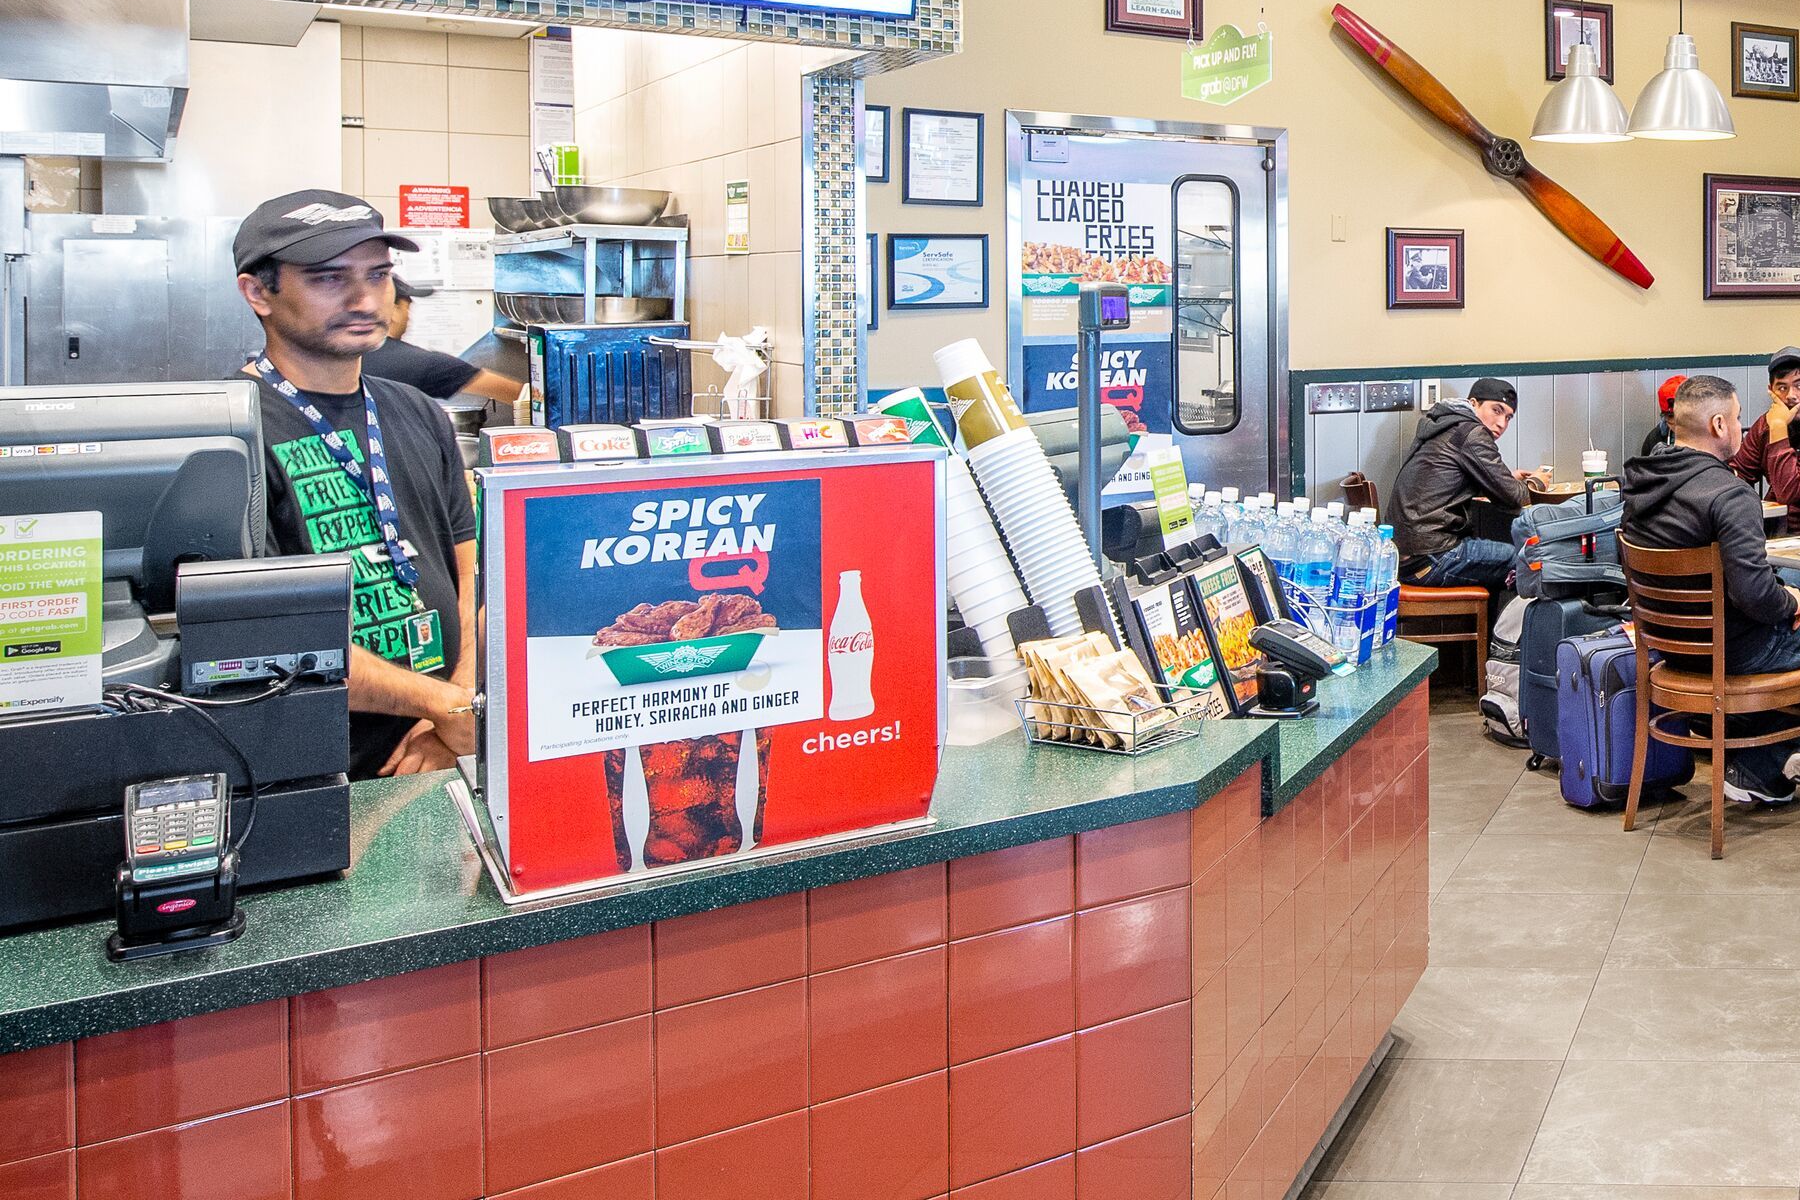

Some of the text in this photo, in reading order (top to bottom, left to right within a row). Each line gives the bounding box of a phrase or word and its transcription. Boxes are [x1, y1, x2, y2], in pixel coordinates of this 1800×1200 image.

[1192, 42, 1257, 70] PICK UP AND FLY!
[1036, 197, 1124, 223] LOADED
[1085, 224, 1155, 250] FRIES
[1070, 349, 1142, 370] SICY
[1045, 368, 1147, 390] KOEAN
[578, 439, 631, 451] Coke
[628, 493, 767, 532] SPICY
[580, 524, 777, 570] KOREAN
[26, 559, 86, 571] LOCATION
[688, 546, 770, 596] Q
[28, 577, 86, 590] THE WAIT
[1, 597, 79, 611] FIRST ORDER
[9, 606, 77, 620] CODE FAST
[20, 622, 79, 635] getgrab.com
[20, 695, 65, 707] Expensify
[572, 682, 731, 718] PERFECT HARMONY OF
[649, 703, 717, 725] SRIRACHA
[721, 698, 748, 715] AND
[752, 690, 800, 711] GINGER
[540, 739, 583, 751] Participating
[583, 736, 616, 745] locations
[801, 720, 902, 755] cheers!
[138, 865, 175, 876] Please
[177, 859, 210, 870] Swipe
